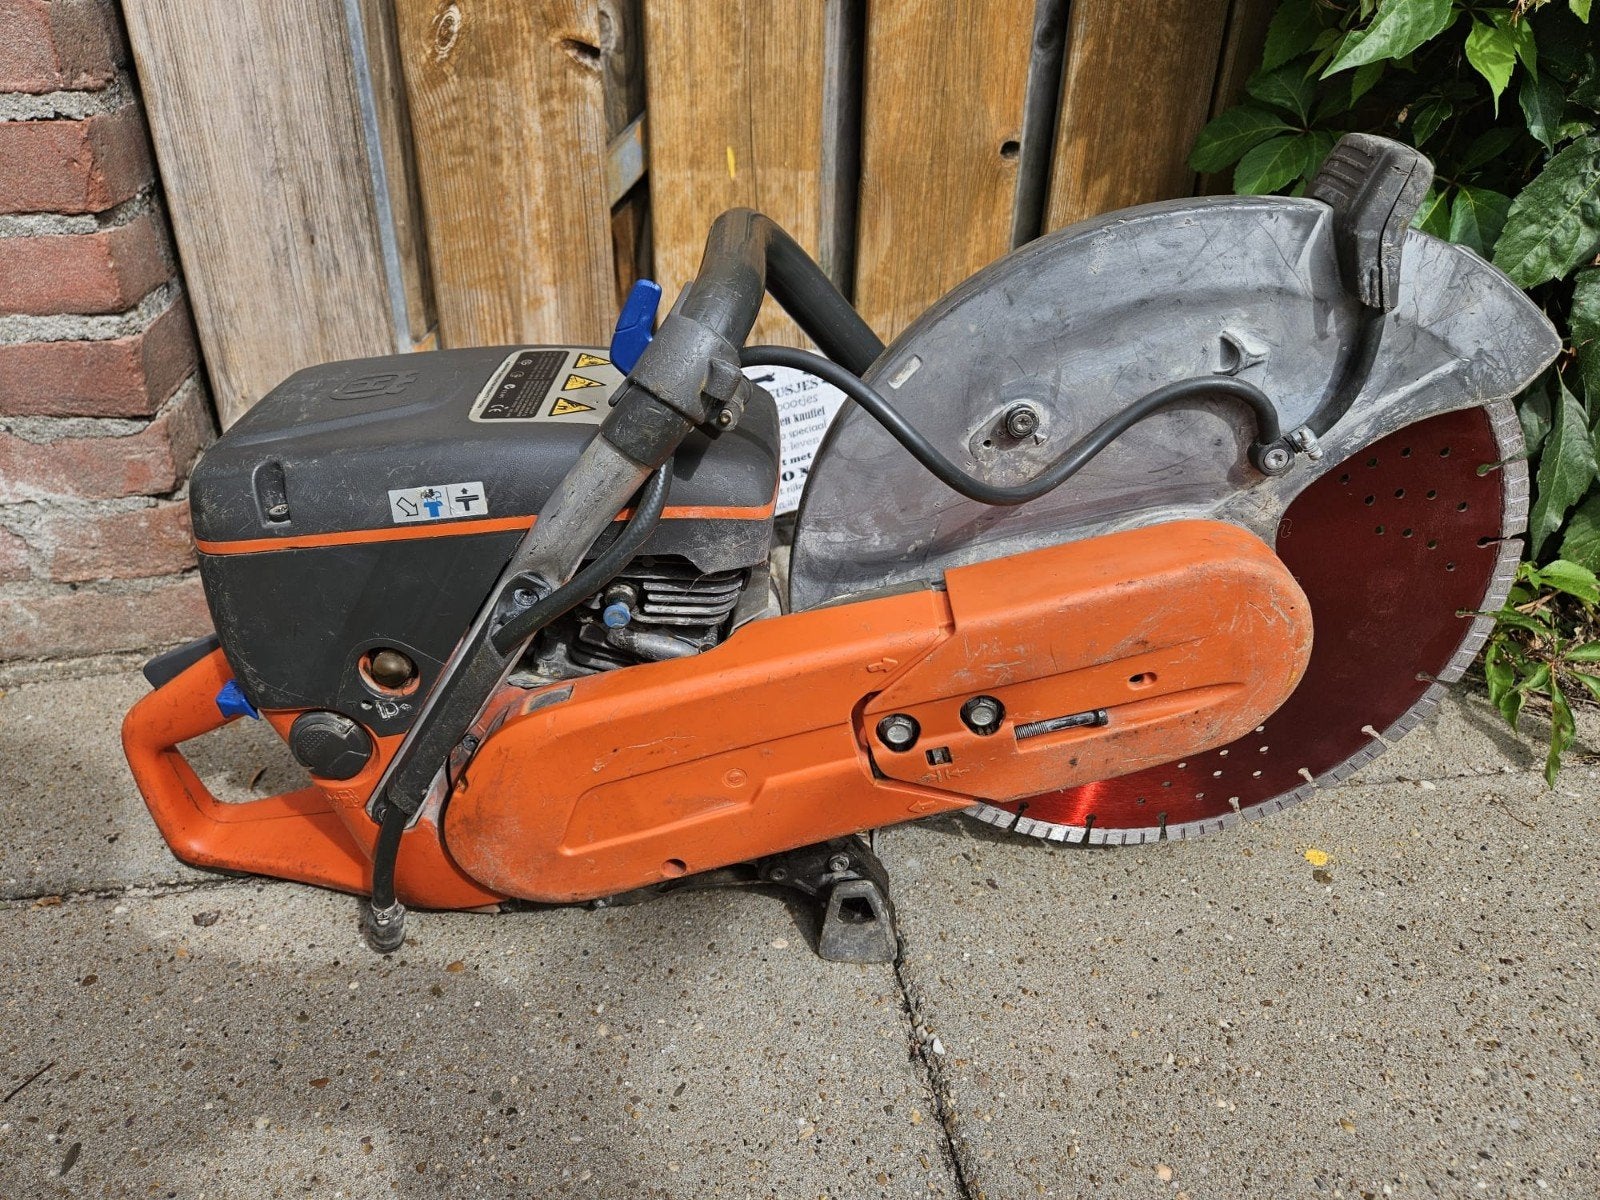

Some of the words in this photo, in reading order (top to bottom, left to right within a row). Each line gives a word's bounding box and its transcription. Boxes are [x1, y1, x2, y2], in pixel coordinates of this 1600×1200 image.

[770, 378, 818, 398] USJES
[793, 405, 825, 422] knuffel
[789, 419, 826, 438] speciaal
[790, 452, 812, 464] met
